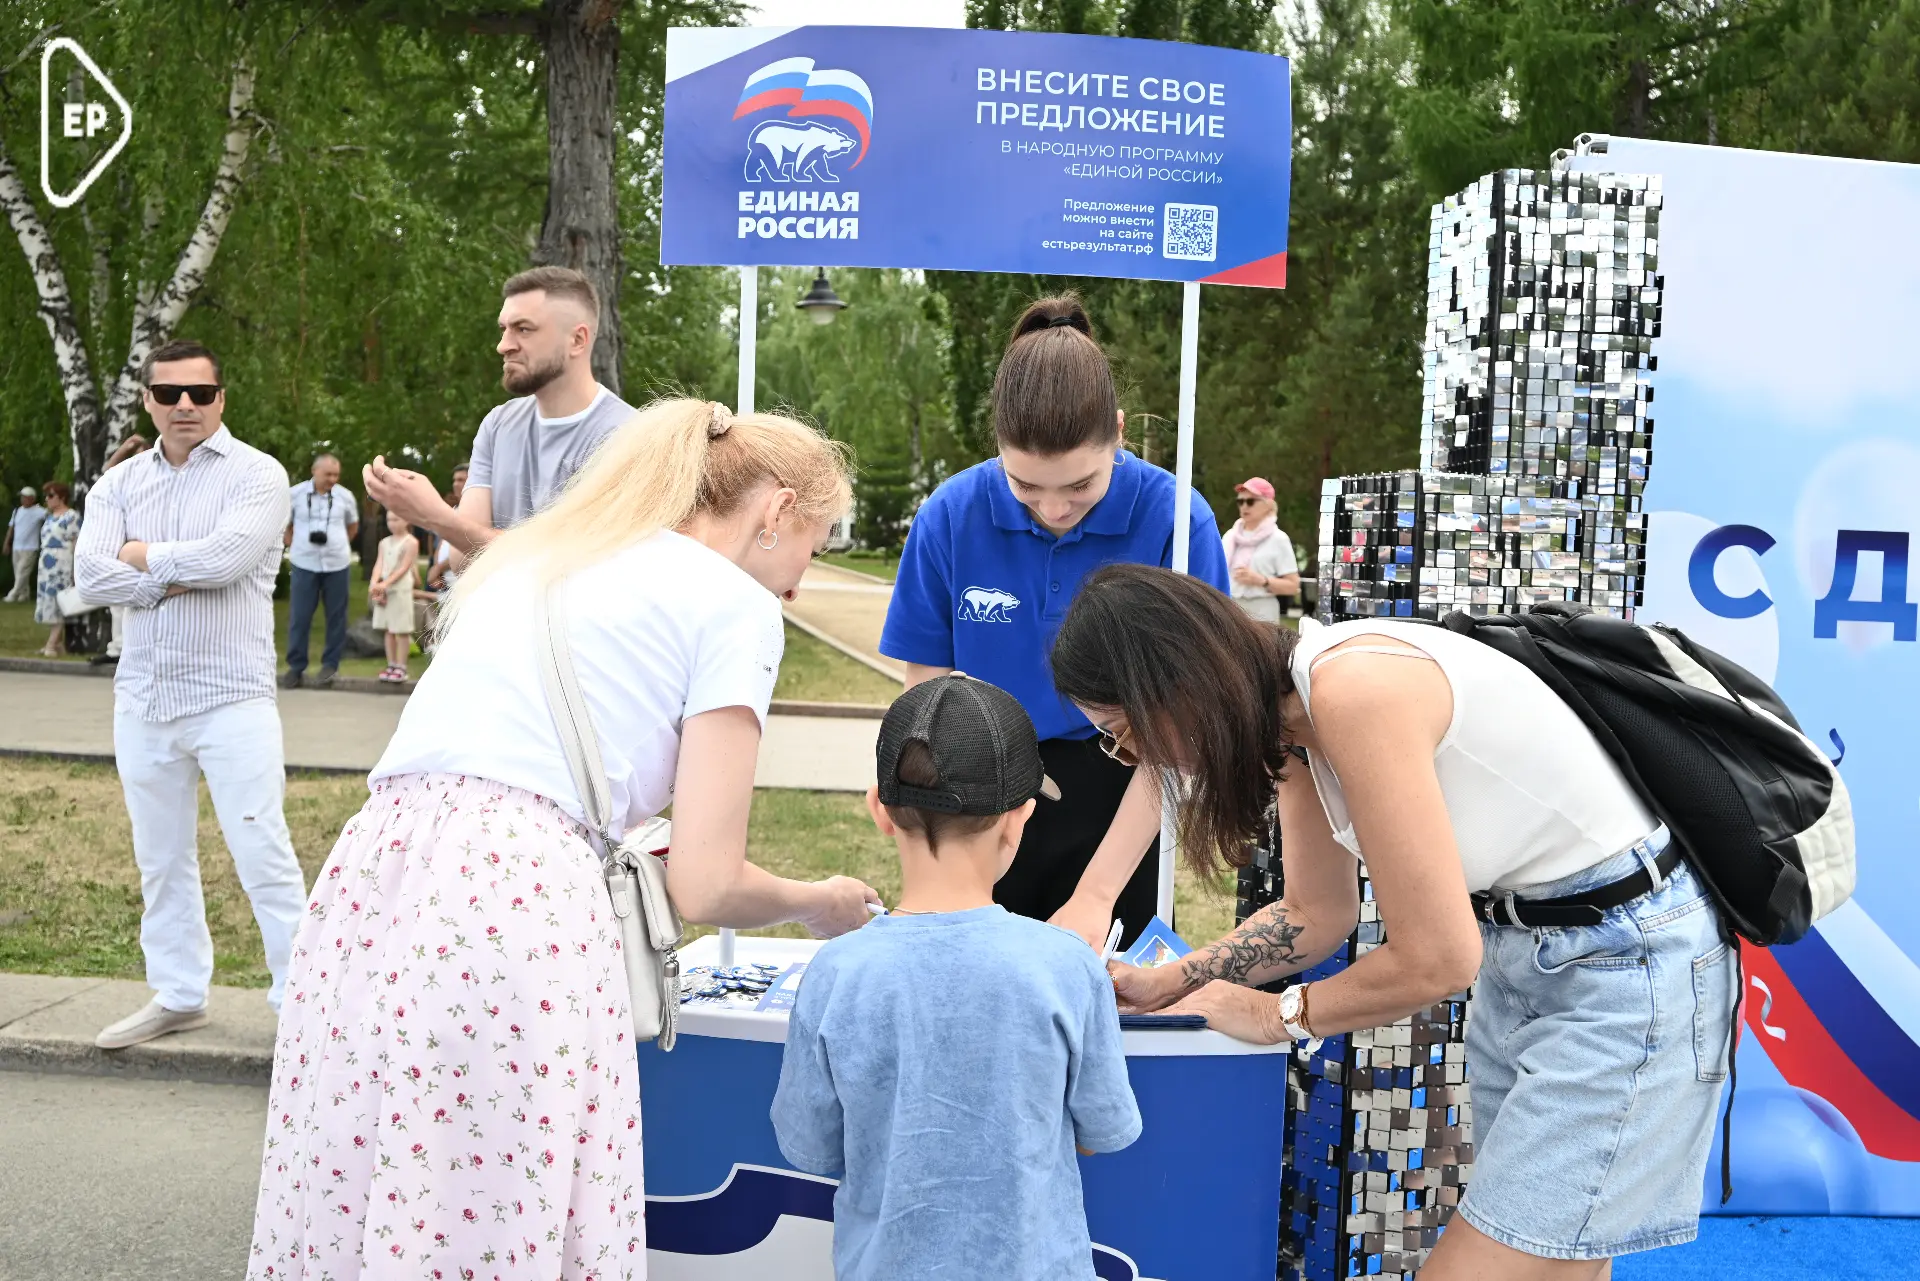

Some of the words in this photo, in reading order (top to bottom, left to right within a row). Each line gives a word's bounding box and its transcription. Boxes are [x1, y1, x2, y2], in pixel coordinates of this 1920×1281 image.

[977, 67, 1129, 98] ВНЕСИТЕ
[1139, 77, 1226, 106] СВОЕ
[976, 101, 1225, 138] ПРЕДЛОЖЕНИЕ
[1001, 140, 1012, 153] В
[1017, 141, 1115, 158] НАРОДНУЮ
[1120, 146, 1224, 165] ПРОГРАММУ
[1063, 163, 1142, 179] «ЕДИНОЙ
[1148, 167, 1223, 184] РОССИИ»
[738, 191, 860, 214] ЕДИНАЯ
[1064, 198, 1155, 213] Предложение
[738, 216, 859, 239] РОССИЯ
[1063, 213, 1107, 224] можно
[1110, 215, 1154, 227] внести
[1099, 229, 1115, 238] на
[1118, 229, 1154, 240] сайте
[1042, 239, 1154, 255] естьрезультат.рф
